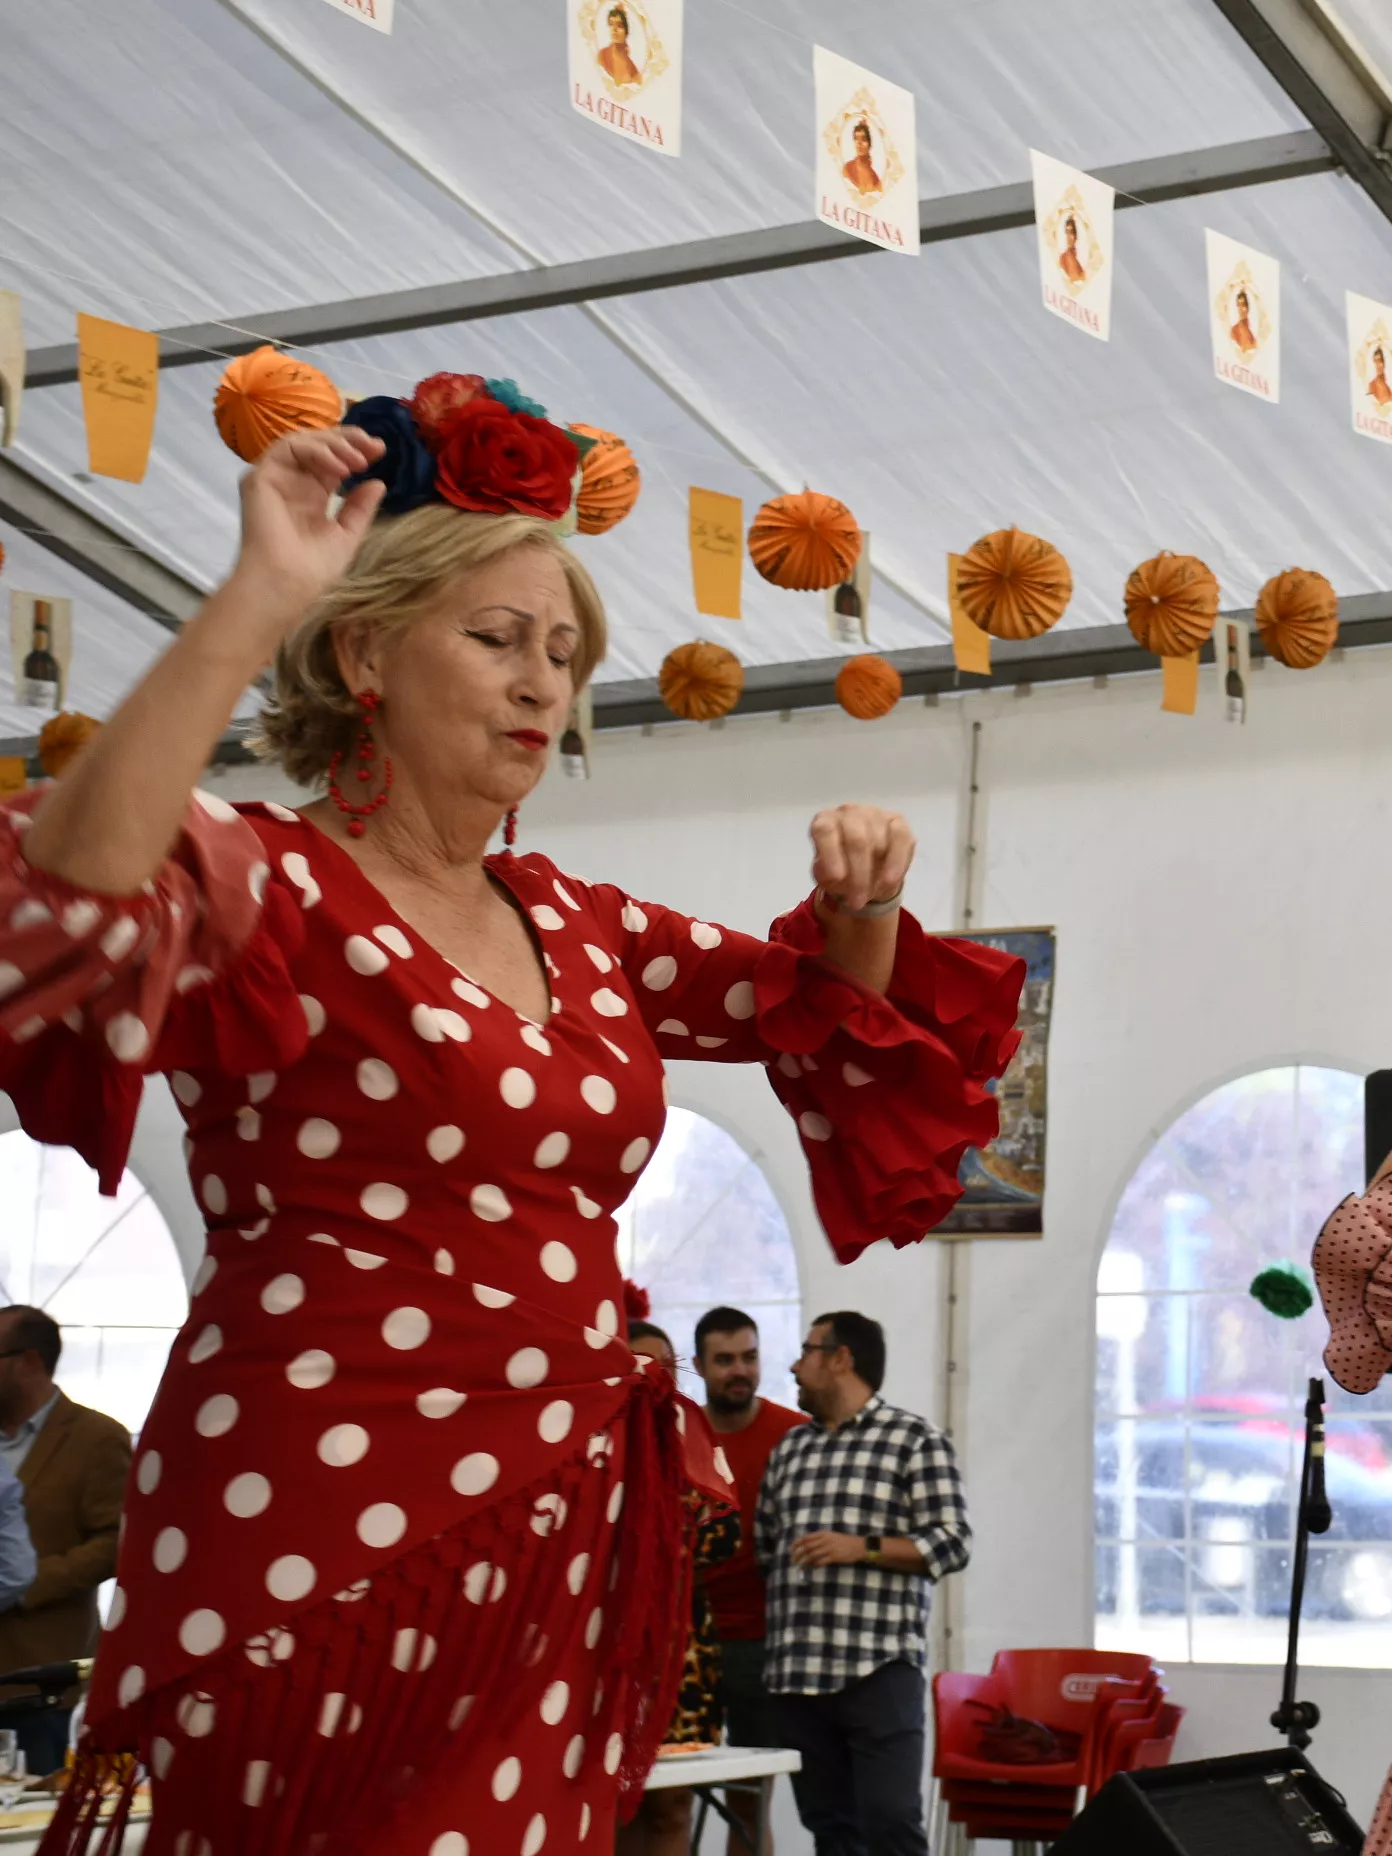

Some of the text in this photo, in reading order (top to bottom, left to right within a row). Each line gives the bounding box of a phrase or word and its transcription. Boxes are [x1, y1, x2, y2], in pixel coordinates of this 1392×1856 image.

[574, 82, 664, 146] LA GITANA
[821, 195, 904, 247] LA GITANA
[1044, 284, 1100, 332] LA GITANA
[1216, 356, 1230, 379] LA
[1355, 411, 1368, 432] LA
